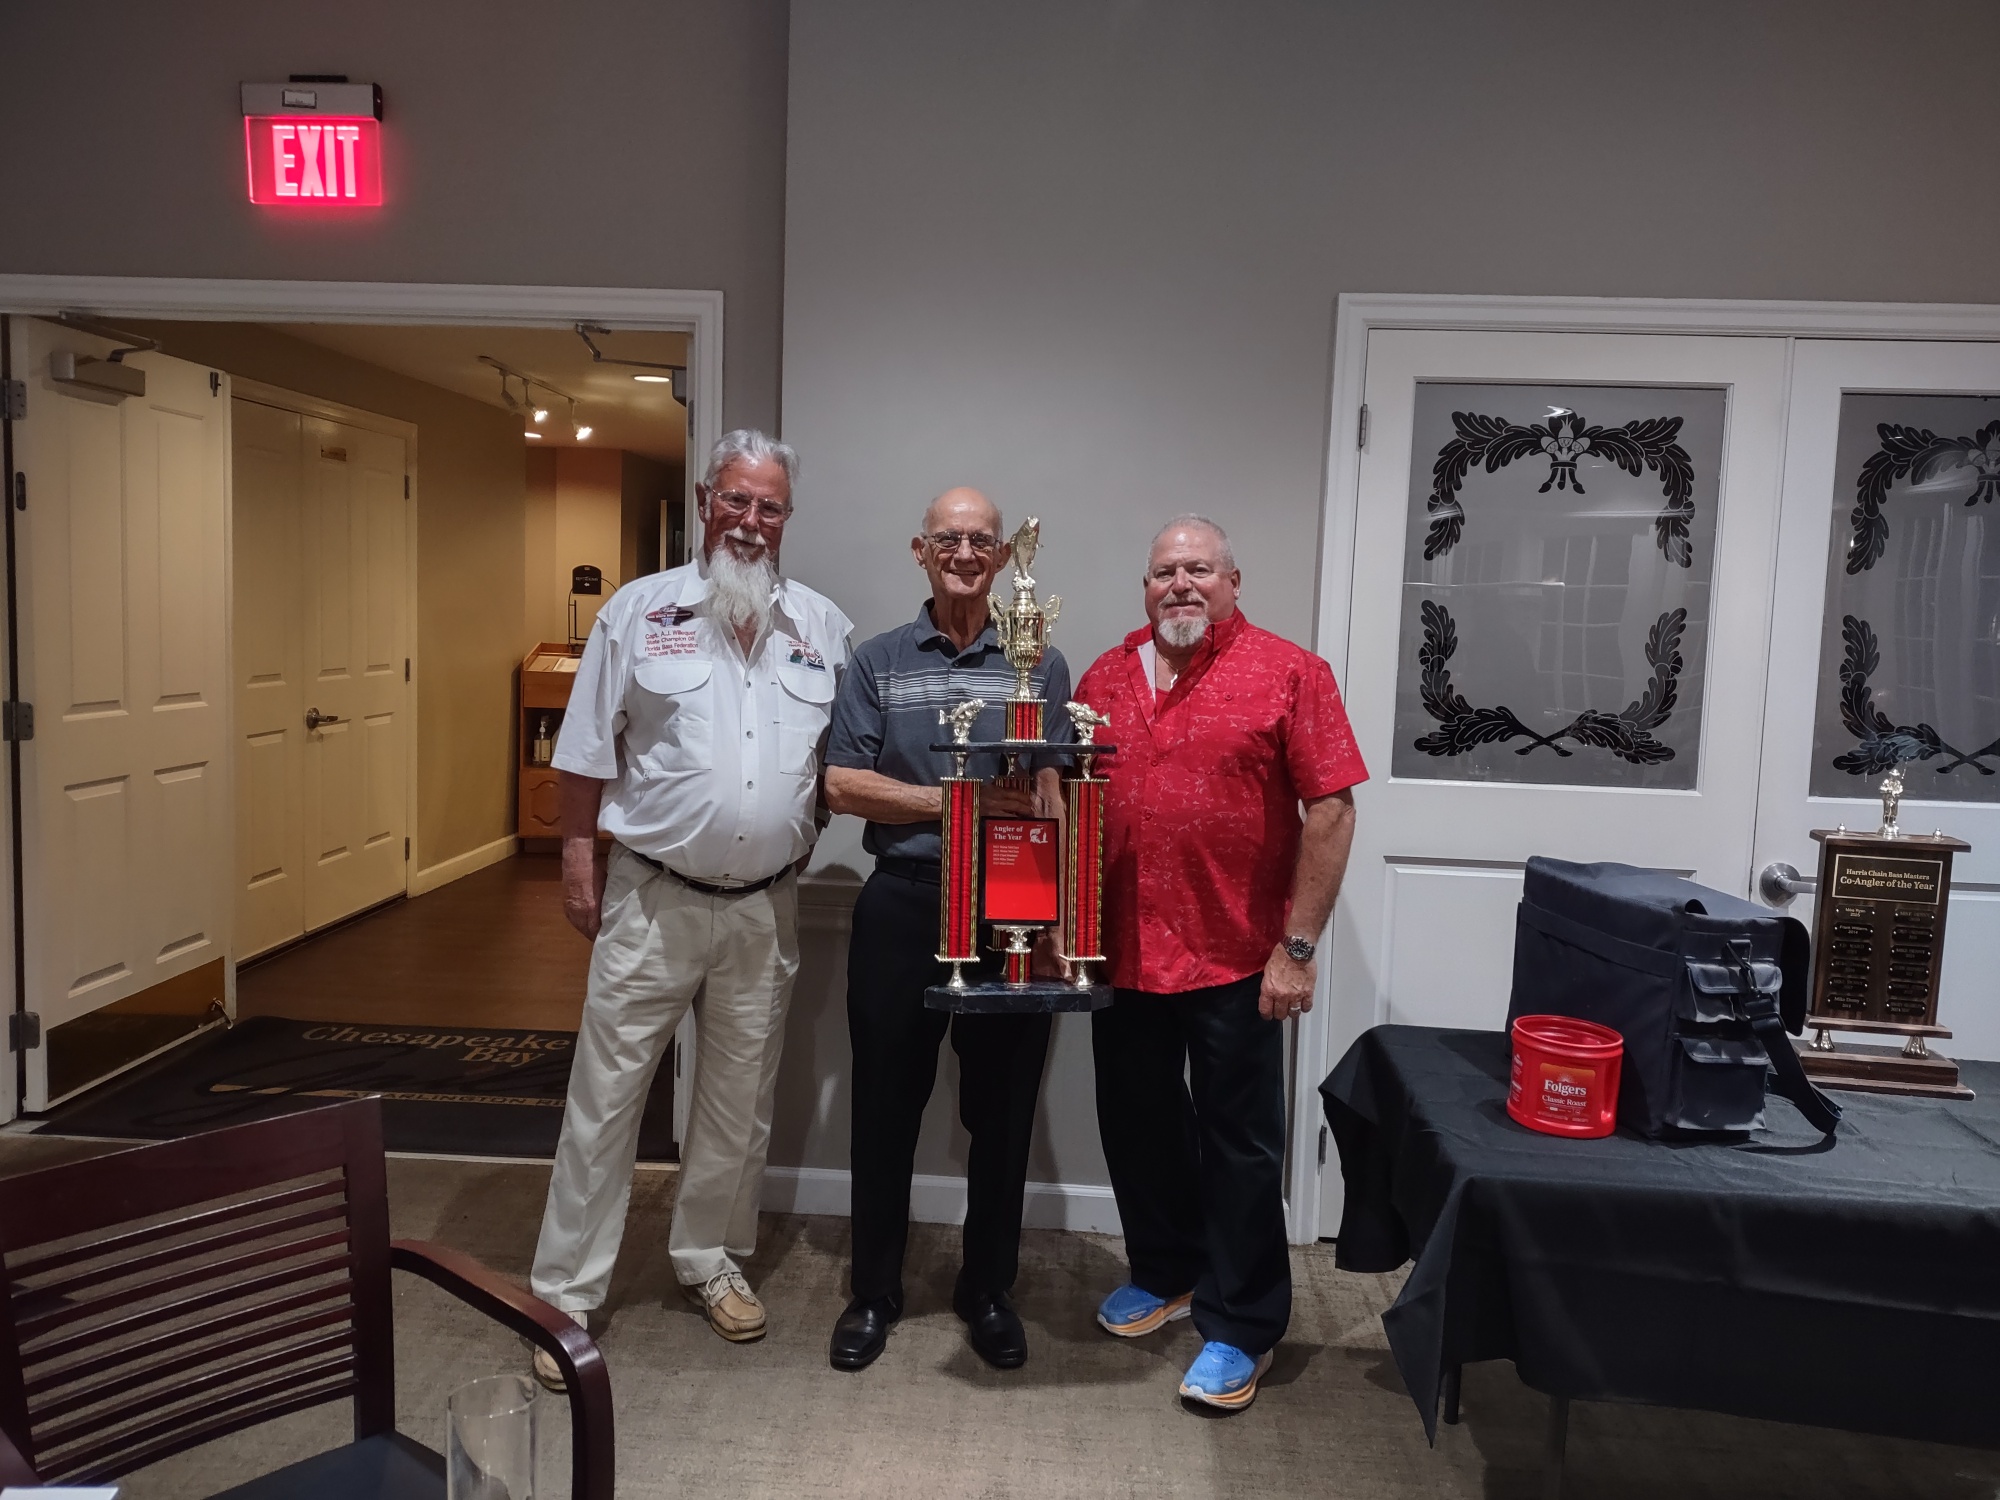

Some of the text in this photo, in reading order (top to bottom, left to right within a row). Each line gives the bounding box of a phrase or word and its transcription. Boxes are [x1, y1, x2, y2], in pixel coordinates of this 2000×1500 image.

[272, 125, 359, 197] EXIT
[1840, 876, 1934, 890] Co-Angler of the Year
[302, 1026, 570, 1051] Chesapeake
[458, 1046, 545, 1068] Bay
[1544, 1079, 1587, 1096] Folgers
[384, 1093, 527, 1103] ARLINGTON
[1542, 1094, 1587, 1107] Classic Roast
